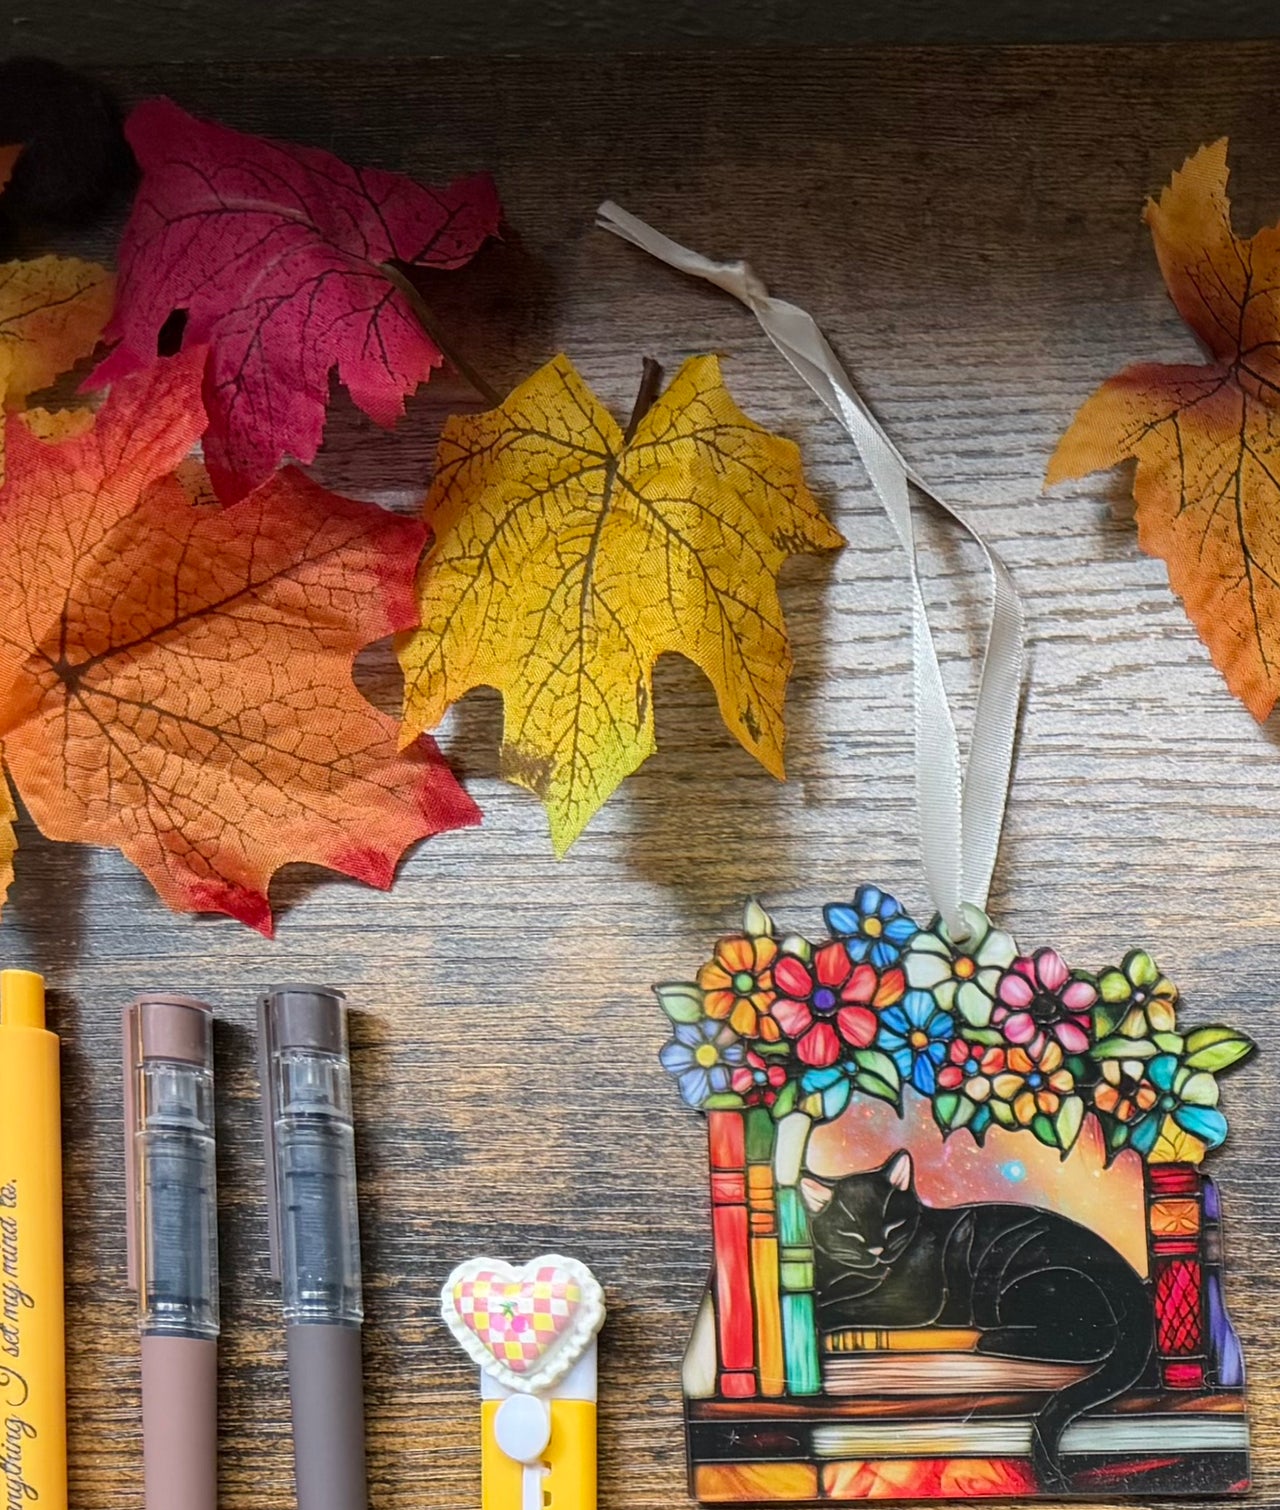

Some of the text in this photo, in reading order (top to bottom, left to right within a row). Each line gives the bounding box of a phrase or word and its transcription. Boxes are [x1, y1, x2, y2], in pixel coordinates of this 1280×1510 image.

[0, 1215, 19, 1279] mind
[4, 1280, 35, 1323] my
[0, 1322, 20, 1359] set
